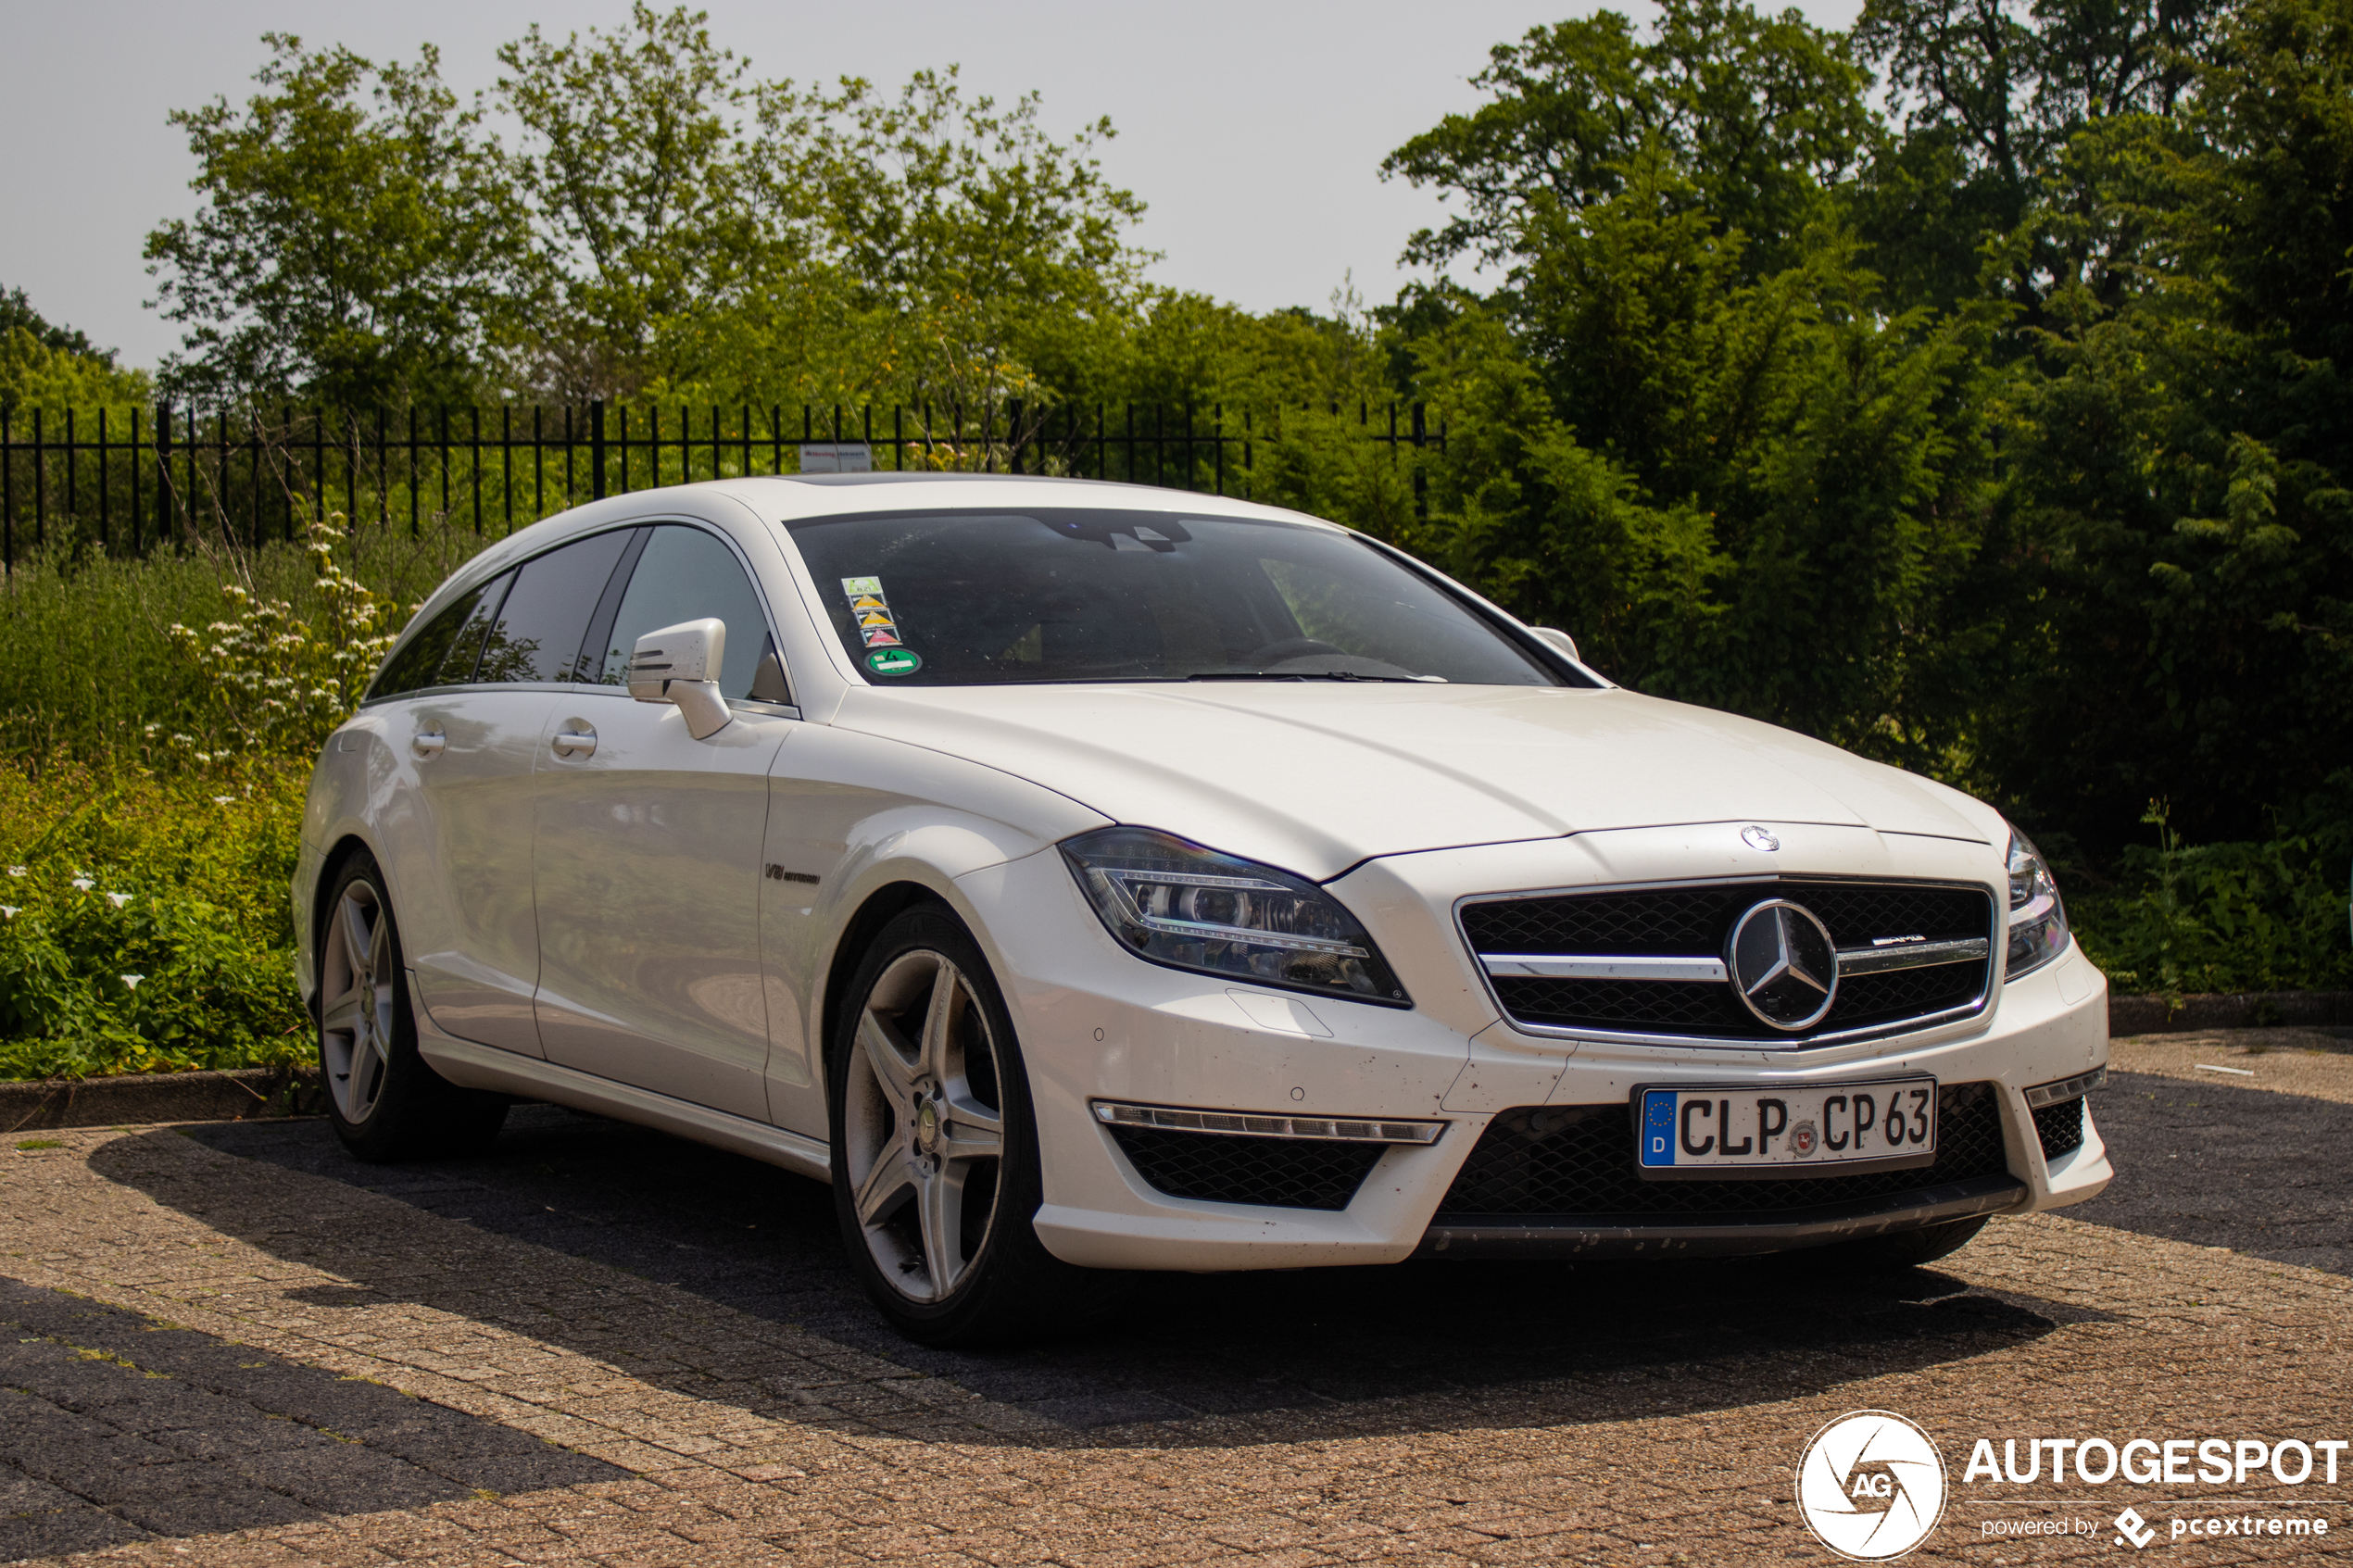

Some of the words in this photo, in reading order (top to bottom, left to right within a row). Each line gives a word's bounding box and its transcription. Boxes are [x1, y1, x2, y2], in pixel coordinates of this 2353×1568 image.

[885, 651, 900, 661] 4
[766, 862, 784, 880] V8
[1680, 1098, 1788, 1156] CLP
[1823, 1094, 1875, 1151] CP
[1885, 1089, 1930, 1147] 63
[1653, 1136, 1666, 1153] D
